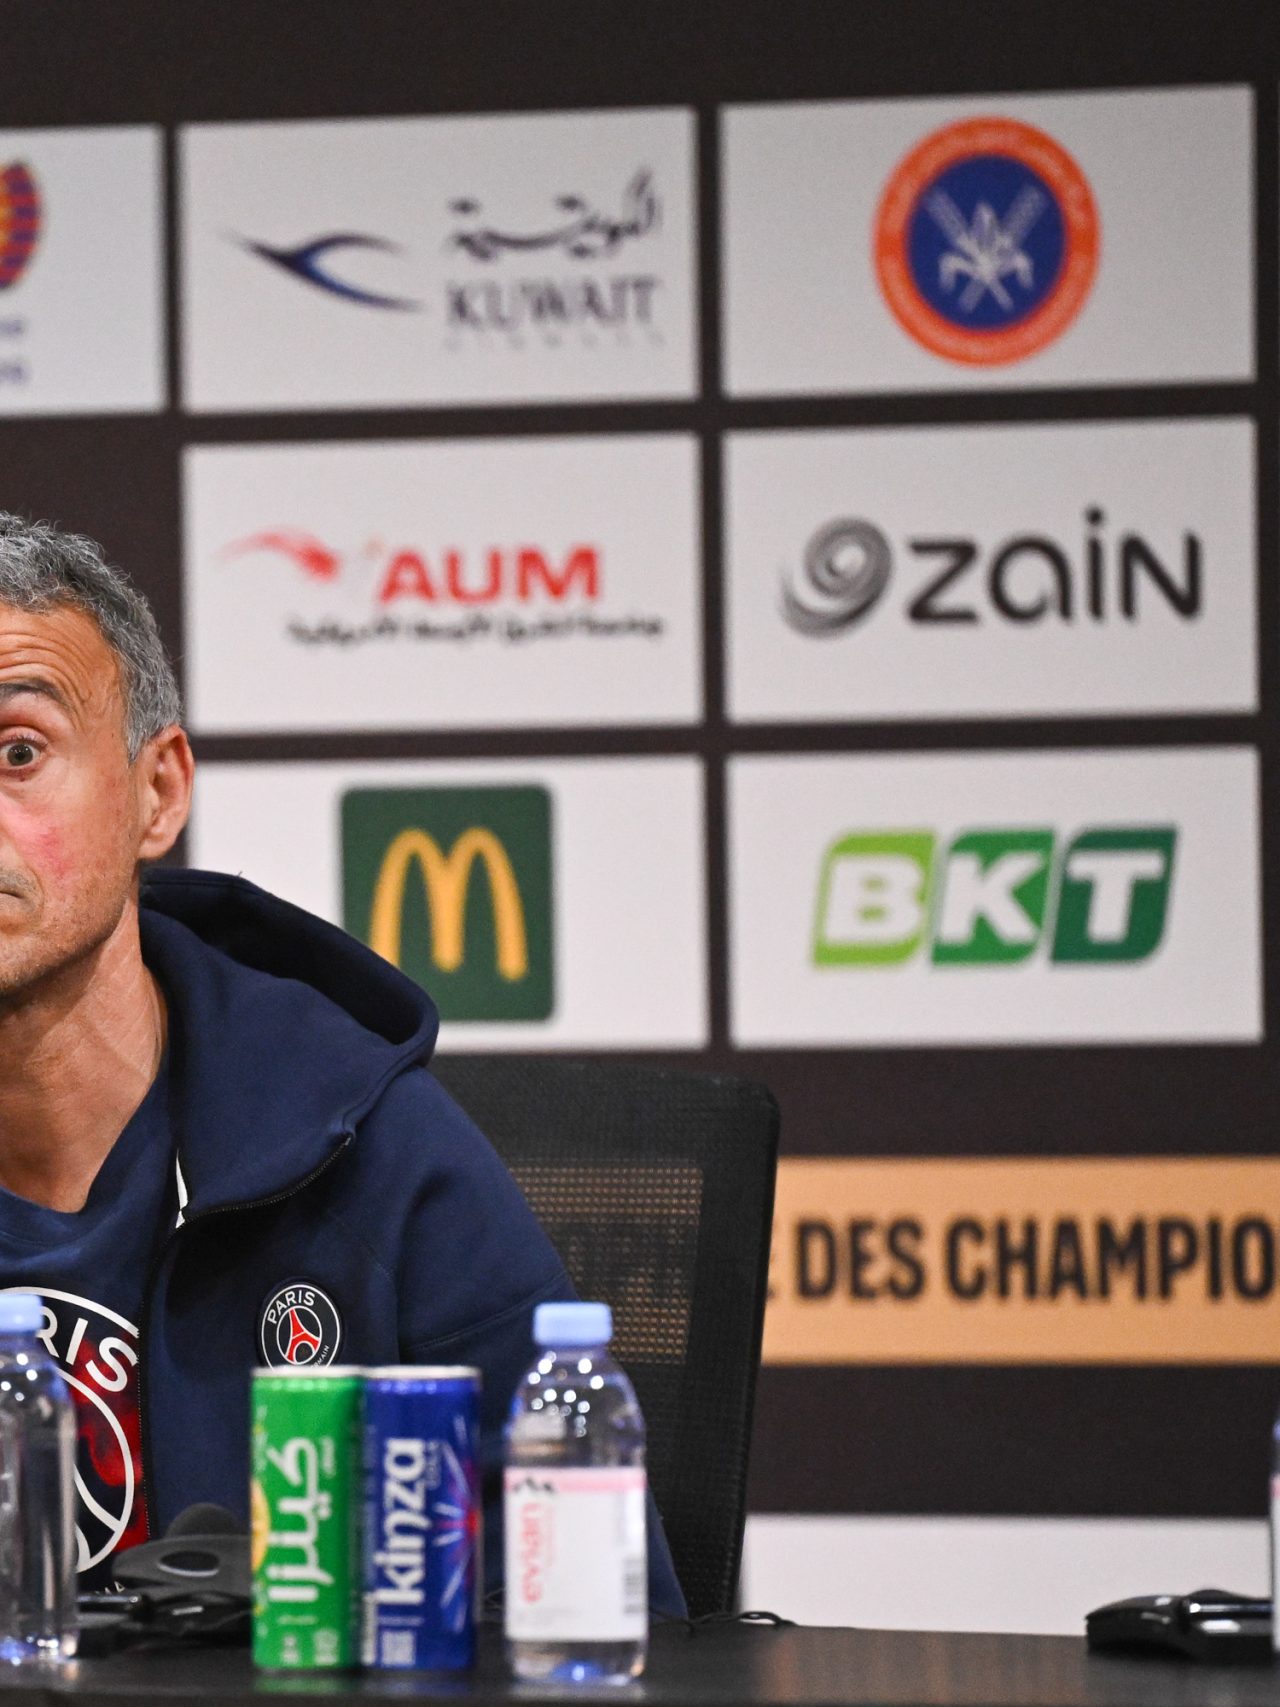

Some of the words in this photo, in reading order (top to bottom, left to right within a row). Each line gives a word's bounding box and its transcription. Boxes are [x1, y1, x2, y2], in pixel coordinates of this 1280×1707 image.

[447, 274, 659, 331] KUWAIT
[378, 543, 603, 604] AUM
[820, 848, 1167, 948] BKT
[793, 1216, 926, 1303] DES
[944, 1214, 1277, 1303] CHAMPIO
[267, 1290, 316, 1325] PARIS
[372, 1437, 431, 1606] kinza
